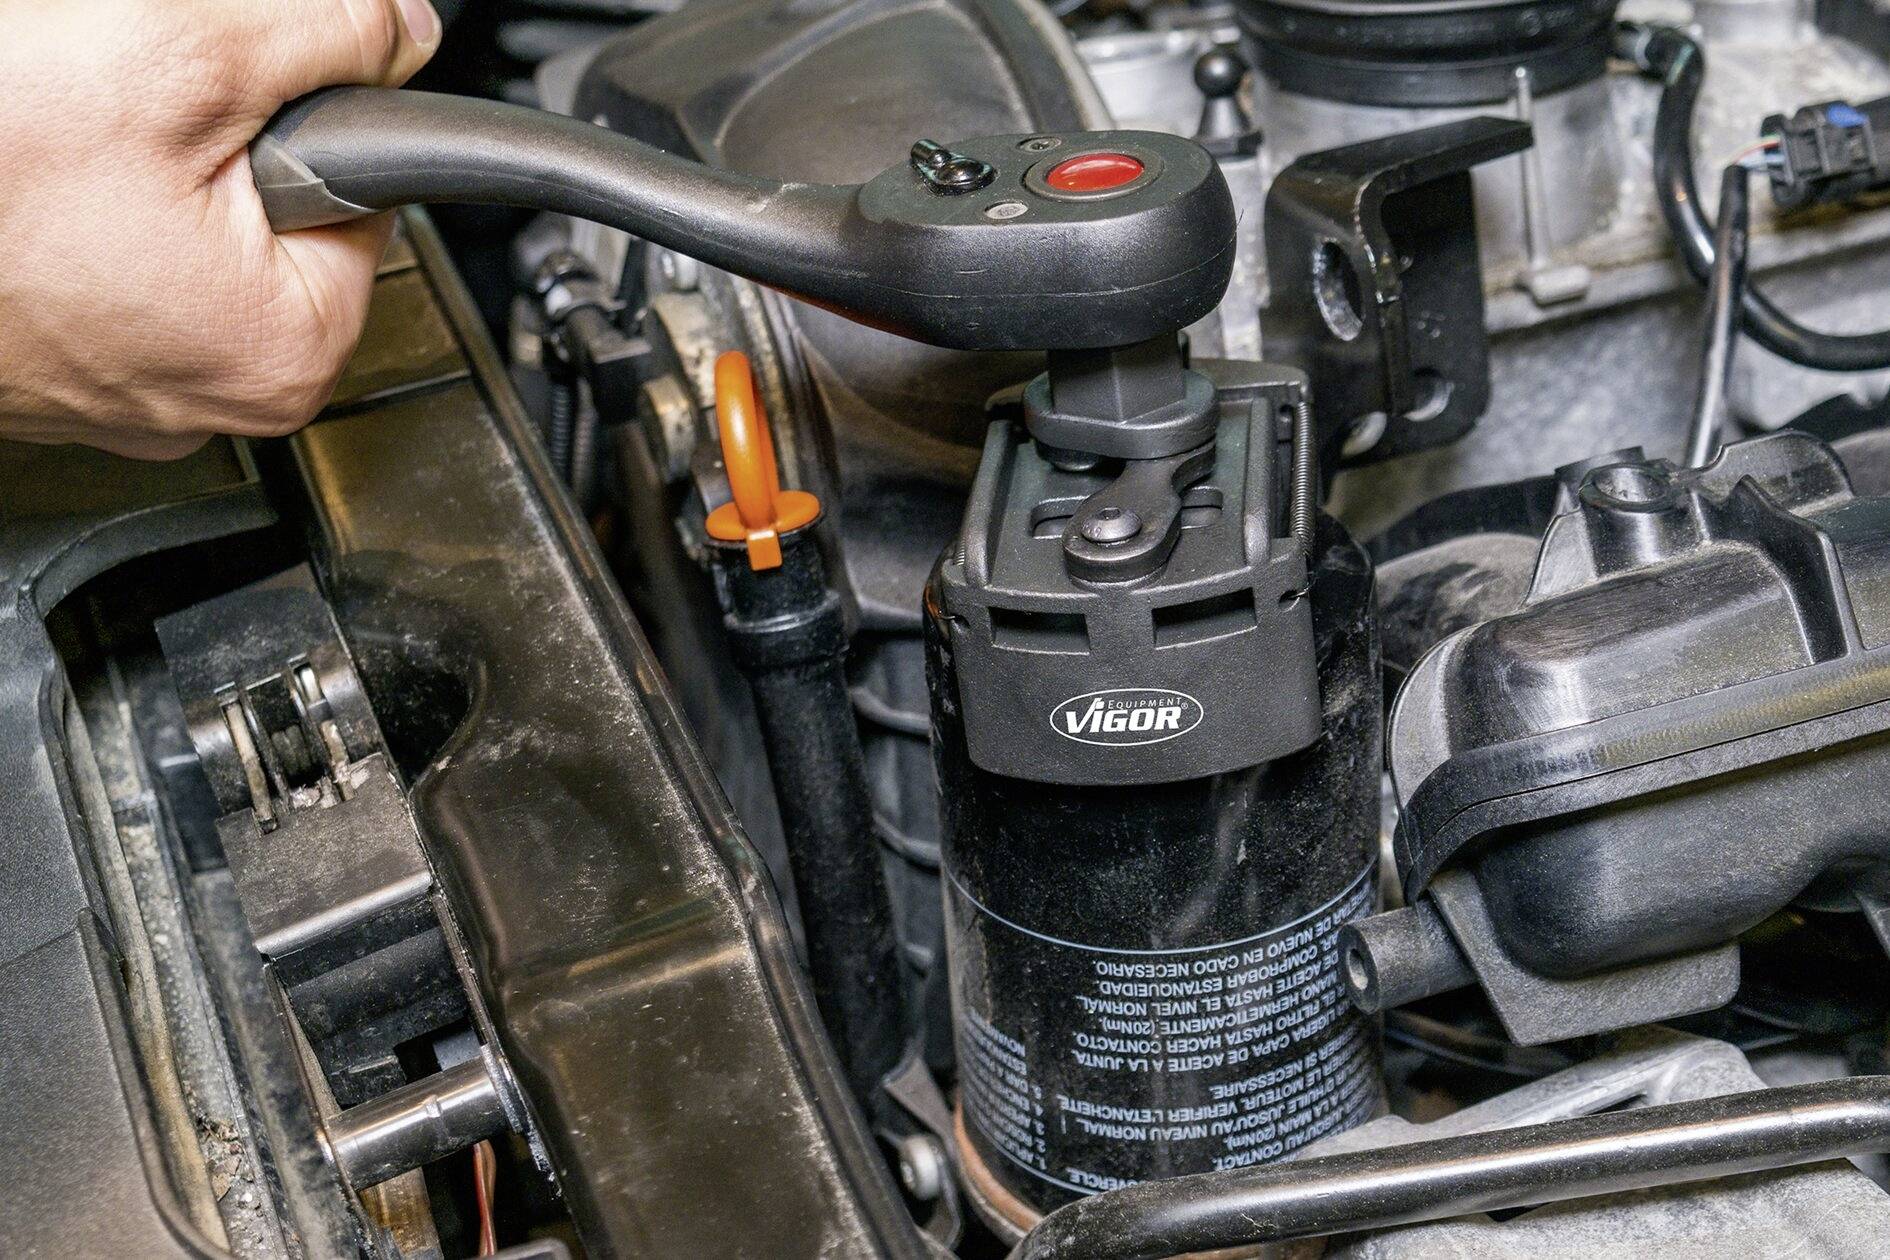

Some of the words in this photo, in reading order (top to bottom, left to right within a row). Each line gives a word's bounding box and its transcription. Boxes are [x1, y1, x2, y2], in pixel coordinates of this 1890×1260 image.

[1108, 697, 1182, 709] EQUIPMENT
[1314, 914, 1332, 938] DE
[1266, 924, 1314, 959] NUEVO
[1092, 960, 1190, 977] NECESARIO.
[1192, 953, 1239, 975] CADO
[1225, 942, 1318, 989] COMPROBAR
[1242, 946, 1265, 967] EN
[1322, 947, 1339, 973] DE
[1095, 976, 1223, 996] ESTANQUEIDAD.
[1275, 958, 1322, 995] ACEITE
[1300, 969, 1337, 1003] MANO
[1075, 994, 1148, 1016] NORMAL.
[1200, 996, 1221, 1013] EL
[1223, 981, 1273, 1009] HASTA
[1320, 987, 1336, 1010] EL
[1150, 999, 1198, 1016] NIVEL
[1159, 988, 1300, 1036] HERMETICAMENTE
[1274, 996, 1320, 1032] FILTRO
[1098, 1016, 1156, 1036] (20Nm).
[1223, 1019, 1273, 1046] HASTA
[1291, 1007, 1336, 1044] LIGERA
[1071, 1029, 1162, 1054] CONTACTO.
[1165, 1033, 1222, 1054] HACER
[1250, 1030, 1290, 1060] CAPA
[1070, 1048, 1125, 1071] JUNTA.
[1127, 1057, 1149, 1072] LA
[1151, 1058, 1164, 1072] A
[1167, 1052, 1225, 1072] ACEITE
[1226, 1047, 1249, 1065] DE
[1304, 1050, 1317, 1070] SI
[1207, 1058, 1303, 1100] NECESSAIRE.
[1304, 1065, 1321, 1088] LE
[1240, 1074, 1304, 1112] MOTEUR.
[1167, 1099, 1238, 1122] VERIFIER
[1210, 1101, 1286, 1137] JUSQU'AU
[1313, 1096, 1329, 1120] LA
[1075, 1117, 1147, 1141] NORMAL.
[1149, 1124, 1208, 1141] NIVEAU
[1277, 1108, 1312, 1137] MAIN
[1223, 1123, 1276, 1151] (20Nm).
[1212, 1138, 1283, 1171] CONTACT.
